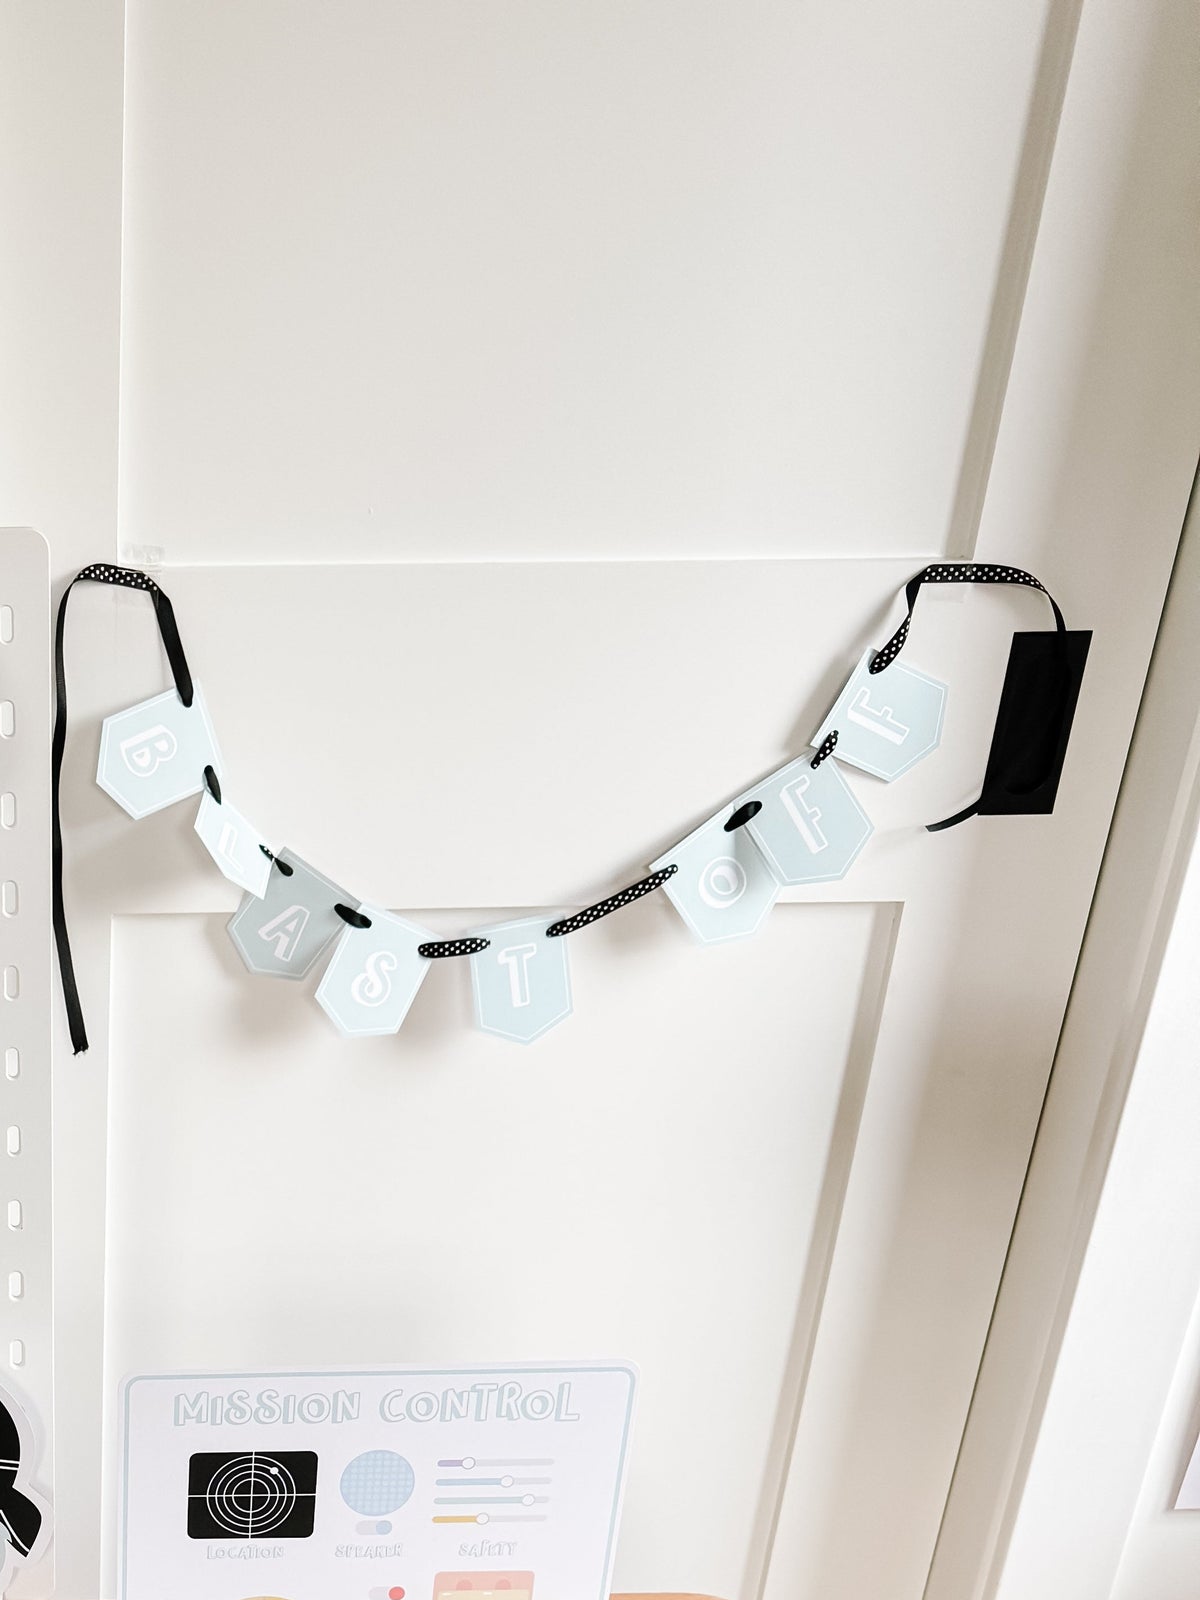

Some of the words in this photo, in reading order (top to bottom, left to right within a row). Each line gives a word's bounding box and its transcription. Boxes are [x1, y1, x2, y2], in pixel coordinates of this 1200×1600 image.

[174, 1388, 361, 1427] MISSION
[379, 1382, 580, 1424] CONTROL
[206, 1544, 285, 1561] LOCATION
[457, 1540, 518, 1558] SAFETY
